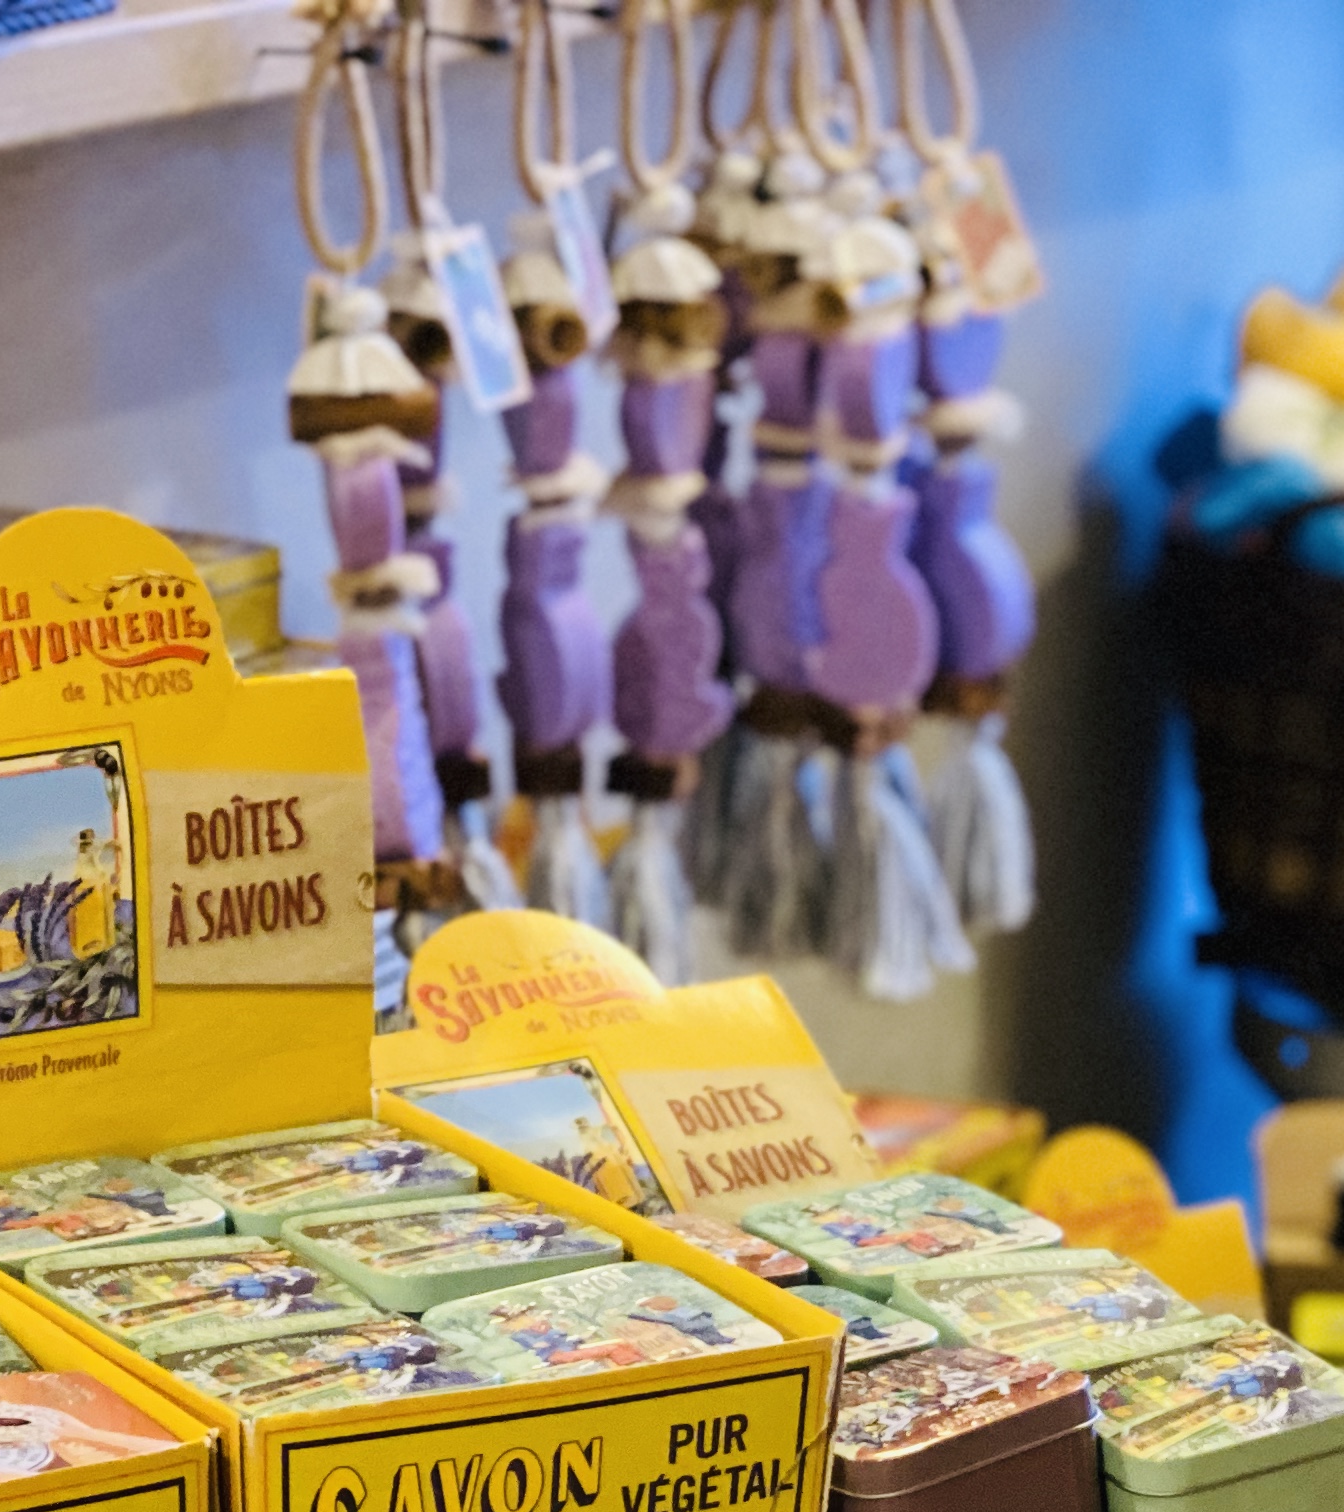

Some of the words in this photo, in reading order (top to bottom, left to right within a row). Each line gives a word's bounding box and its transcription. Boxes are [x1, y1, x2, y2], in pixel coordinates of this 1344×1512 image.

[184, 795, 306, 866] BOÎTES
[167, 882, 189, 949] À
[196, 871, 327, 945] SAVONS
[666, 1081, 786, 1138] BOÎTES
[682, 1147, 711, 1198] À
[712, 1134, 835, 1194] SAVONS
[668, 1412, 749, 1465] PUR
